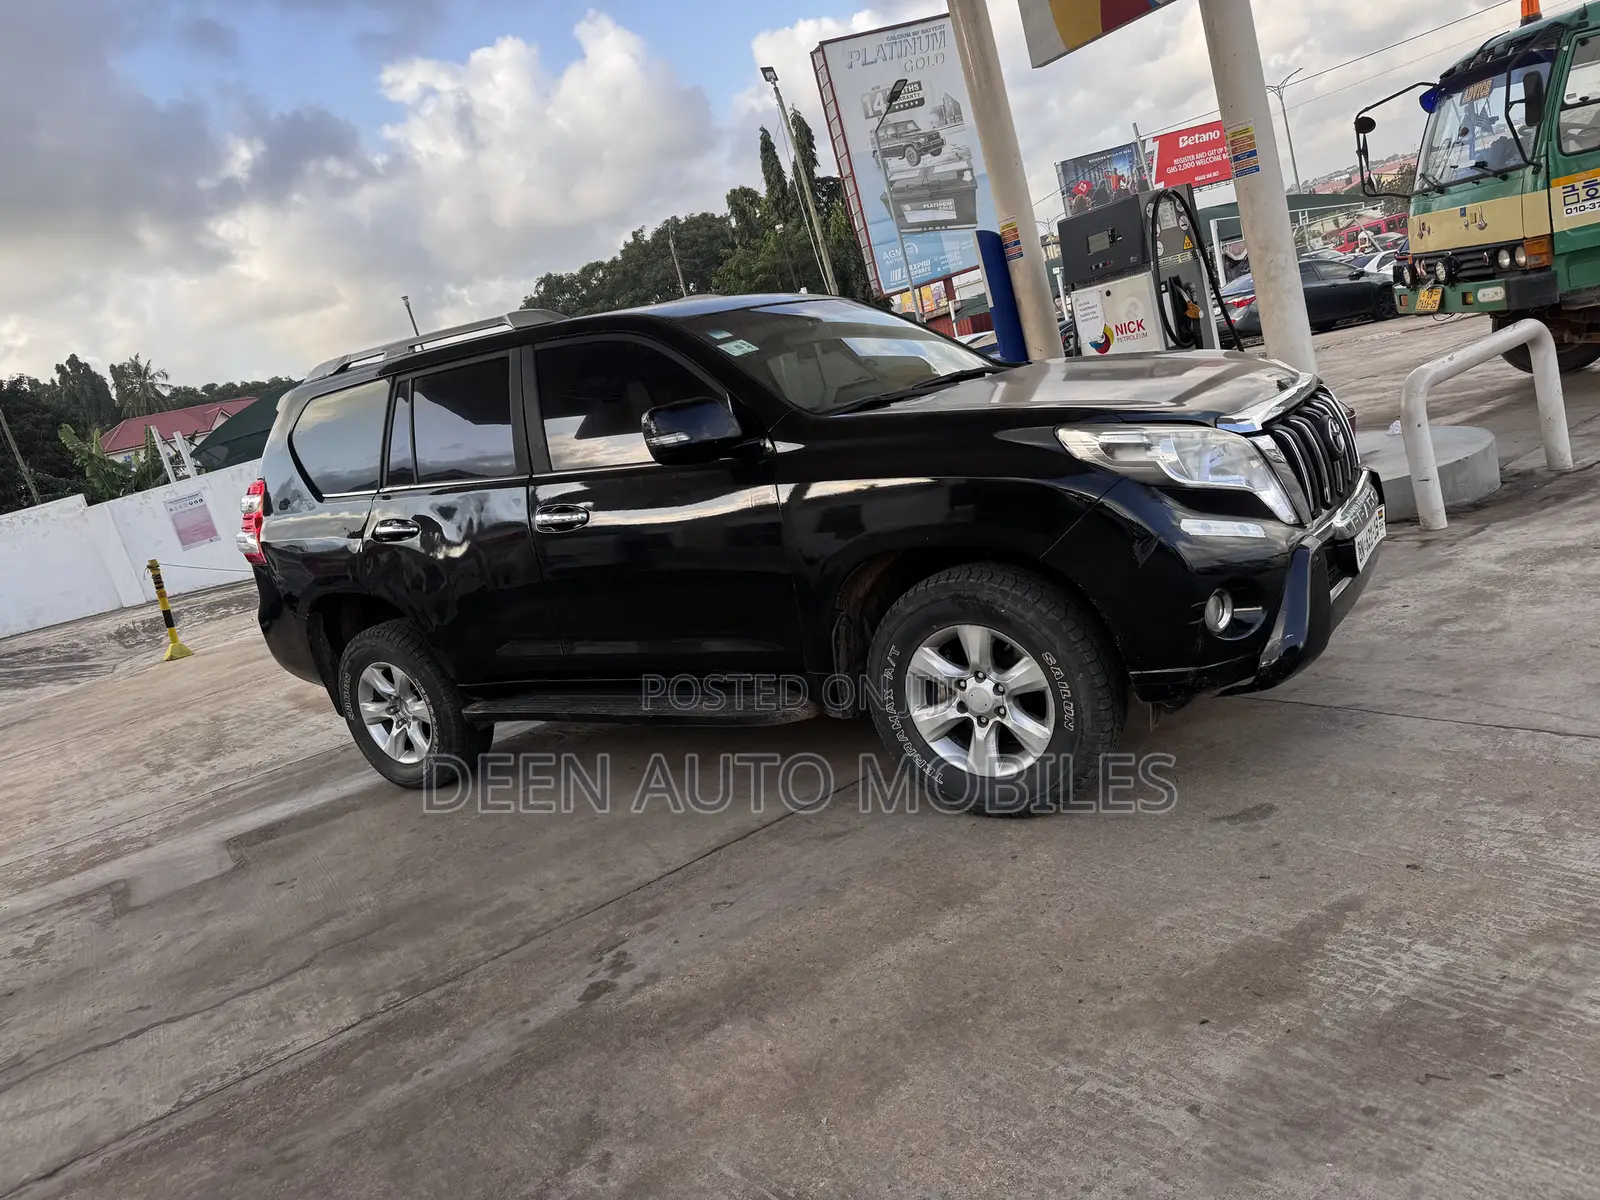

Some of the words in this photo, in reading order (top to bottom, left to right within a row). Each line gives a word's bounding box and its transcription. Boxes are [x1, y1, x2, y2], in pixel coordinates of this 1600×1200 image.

[920, 24, 945, 35] BATTERY
[847, 30, 946, 70] PLATINUM
[904, 52, 945, 73] GOLD
[1179, 130, 1220, 148] Betano
[1166, 165, 1178, 174] GHS
[1178, 160, 1195, 172] 2,000
[1195, 155, 1222, 167] WELCOME
[1173, 155, 1195, 165] REGISTER
[1196, 151, 1207, 160] AND
[1207, 149, 1217, 157] GET
[923, 200, 952, 209] PLATINUM
[1114, 318, 1146, 337] NICK
[1117, 332, 1148, 343] PETROLEUM
[883, 645, 900, 680] A/T
[1042, 651, 1074, 731] SAILUN
[885, 688, 944, 785] TERRAMAX
